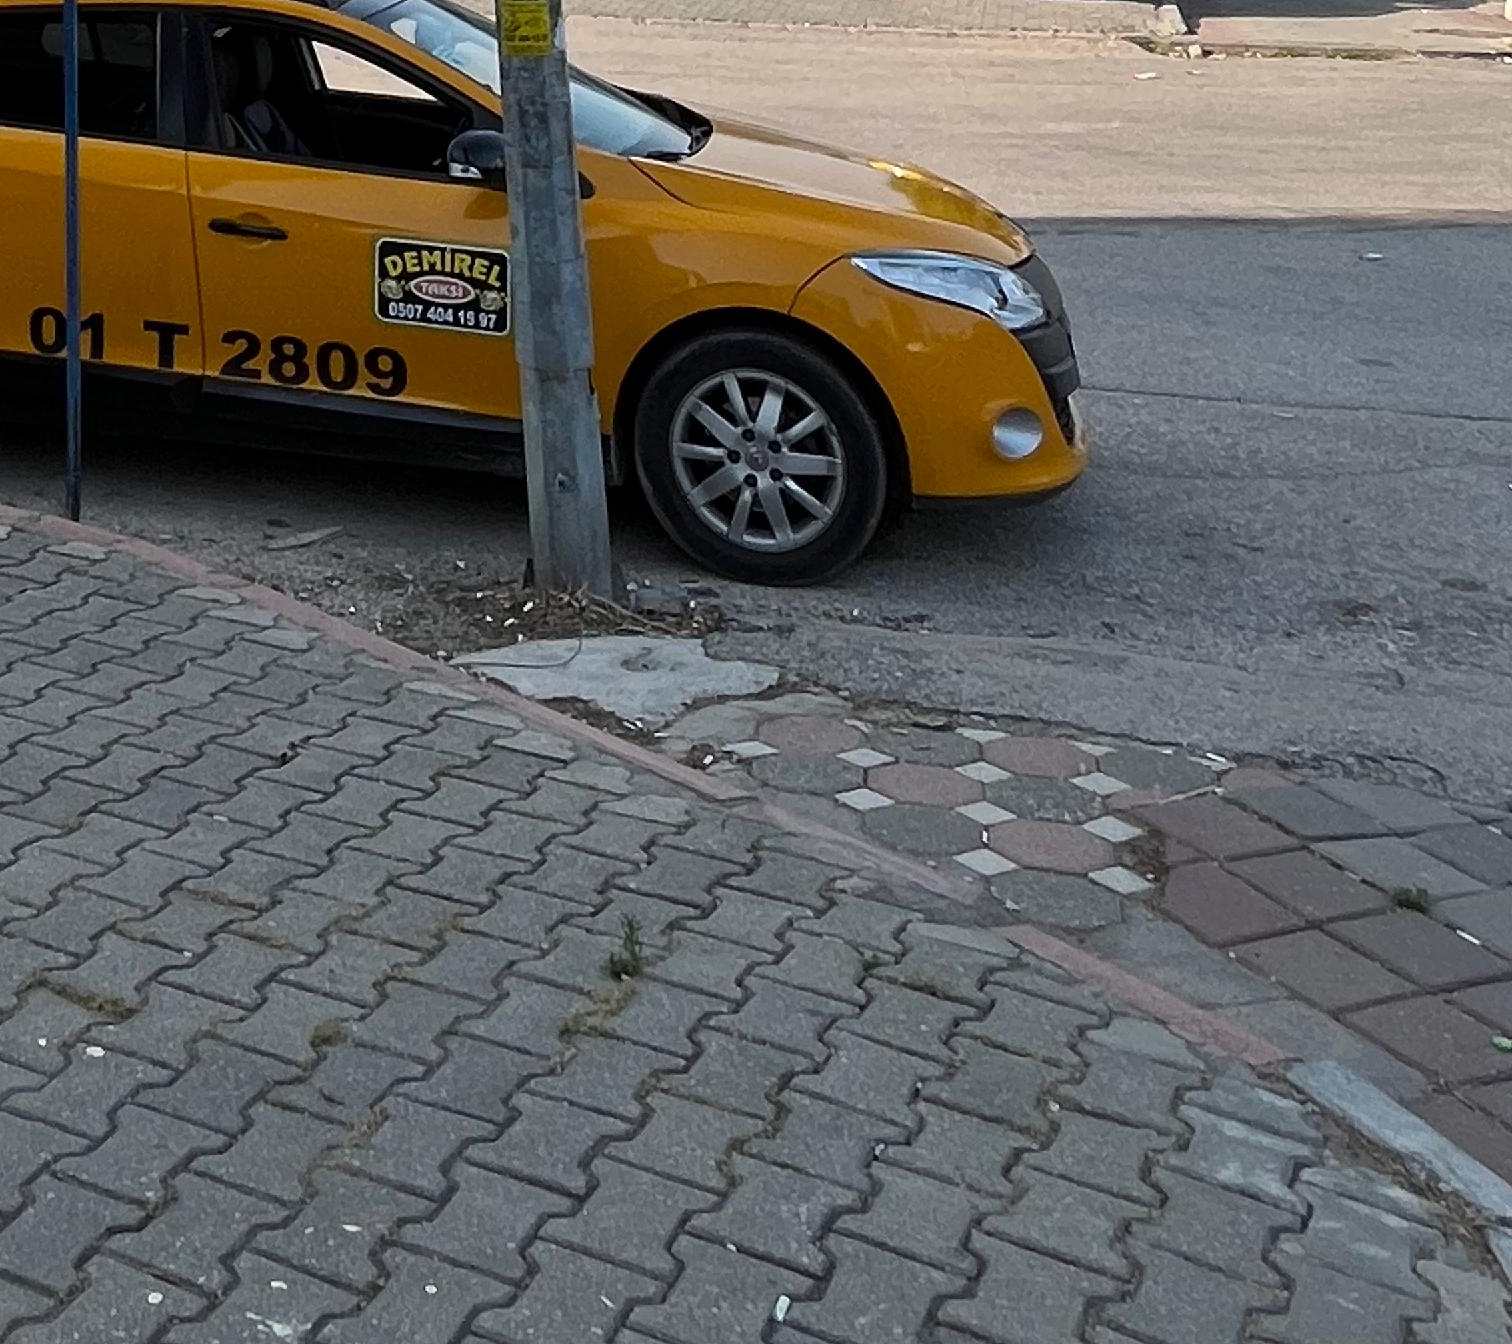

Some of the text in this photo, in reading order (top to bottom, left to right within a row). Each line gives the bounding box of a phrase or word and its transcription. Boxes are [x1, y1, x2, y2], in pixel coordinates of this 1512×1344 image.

[384, 244, 502, 288] DEMİREL
[388, 302, 424, 320] 0507
[426, 306, 454, 324] 404
[478, 312, 498, 330] 97
[29, 306, 408, 398] 01 T 2809
